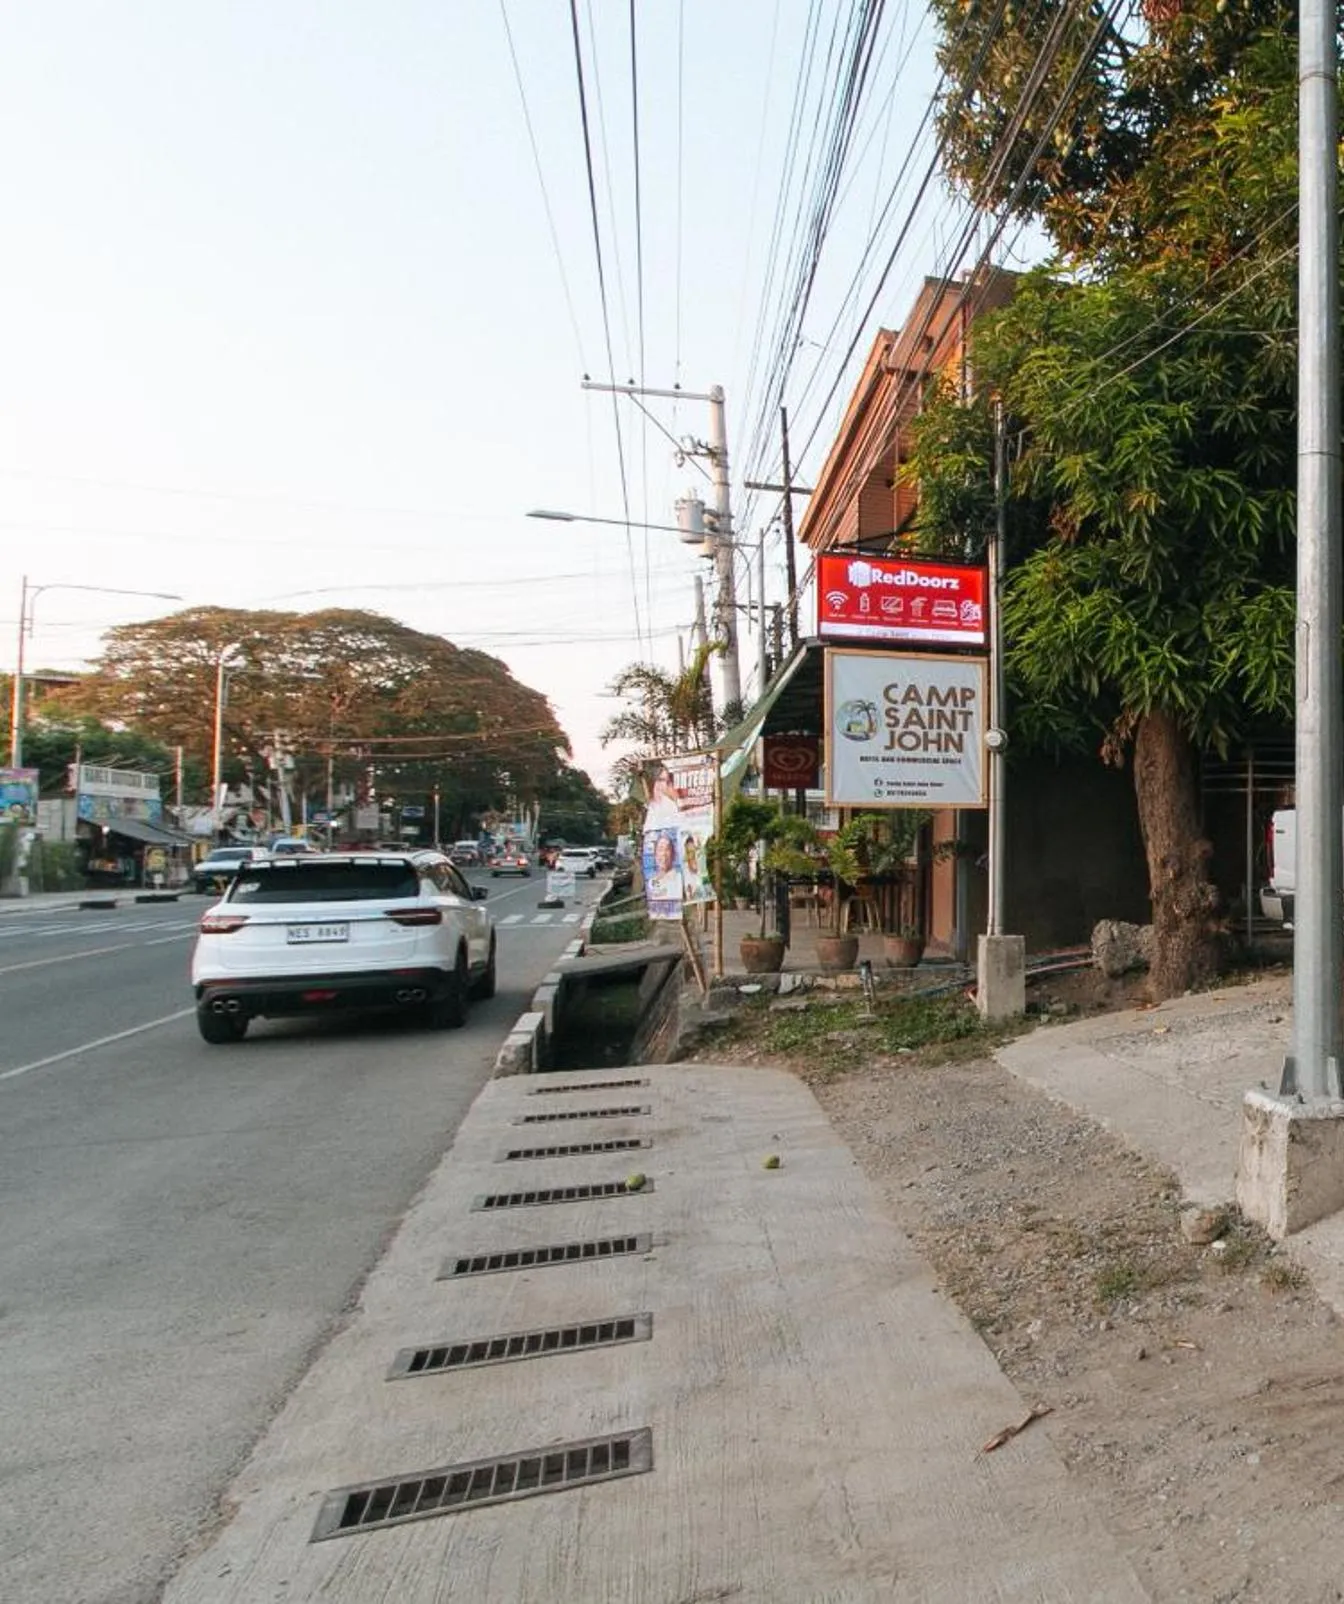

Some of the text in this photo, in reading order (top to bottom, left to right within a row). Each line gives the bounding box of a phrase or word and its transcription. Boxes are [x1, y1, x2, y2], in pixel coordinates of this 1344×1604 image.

[871, 568, 959, 590] RedDoorz
[883, 683, 976, 708] CAMP
[884, 706, 974, 732] SAINT
[884, 730, 964, 753] JOHN
